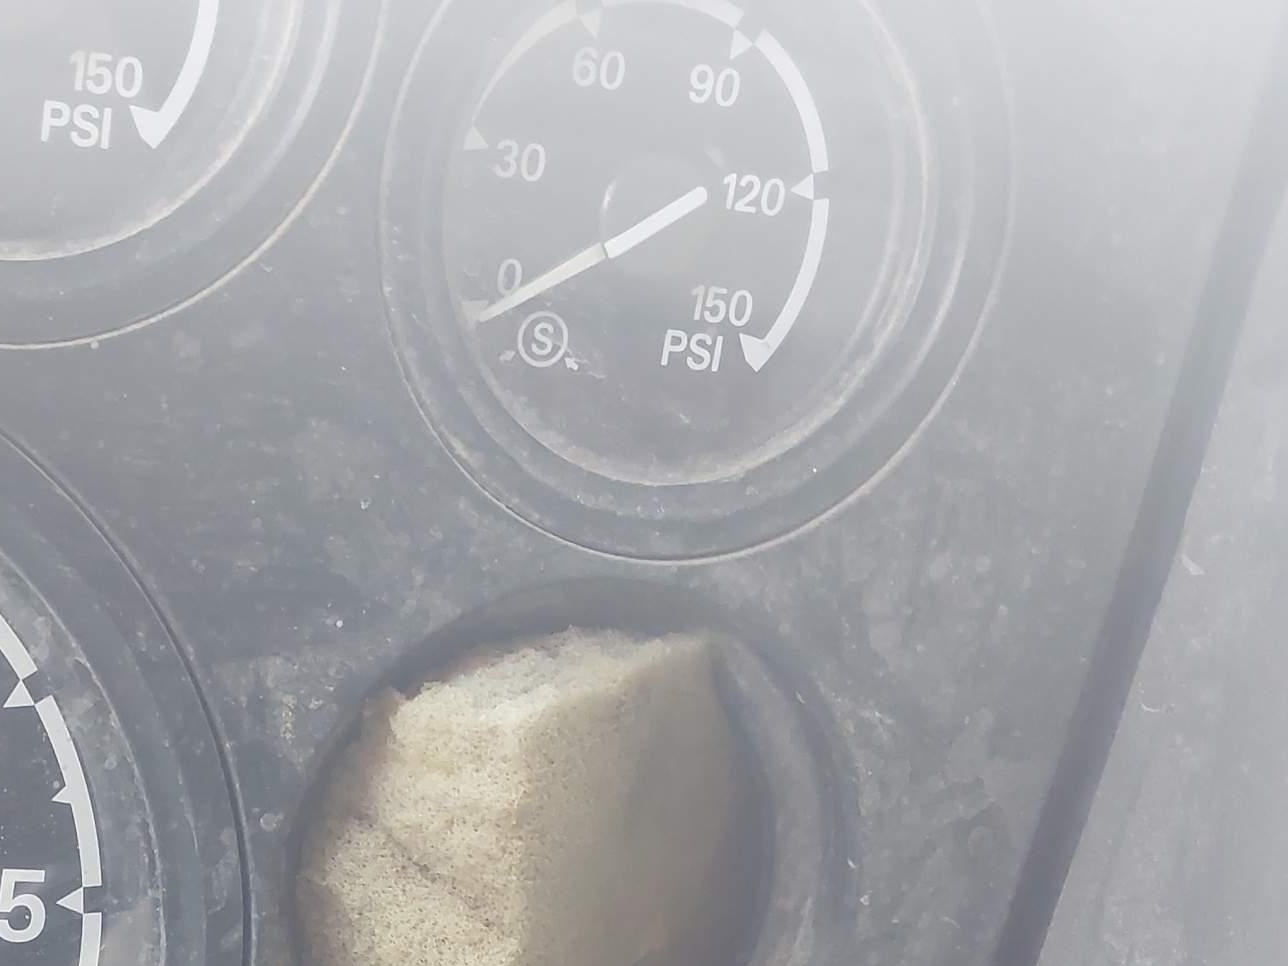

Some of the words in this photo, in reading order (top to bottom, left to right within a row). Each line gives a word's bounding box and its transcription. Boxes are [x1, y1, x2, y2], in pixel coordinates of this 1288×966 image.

[70, 51, 143, 98] 150
[572, 47, 626, 90] 60
[689, 64, 740, 107] 90
[40, 101, 112, 149] PSI
[493, 139, 546, 181] 30
[721, 173, 785, 216] 120
[497, 259, 522, 297] 0
[690, 285, 752, 328] 150
[661, 329, 722, 372] PSI
